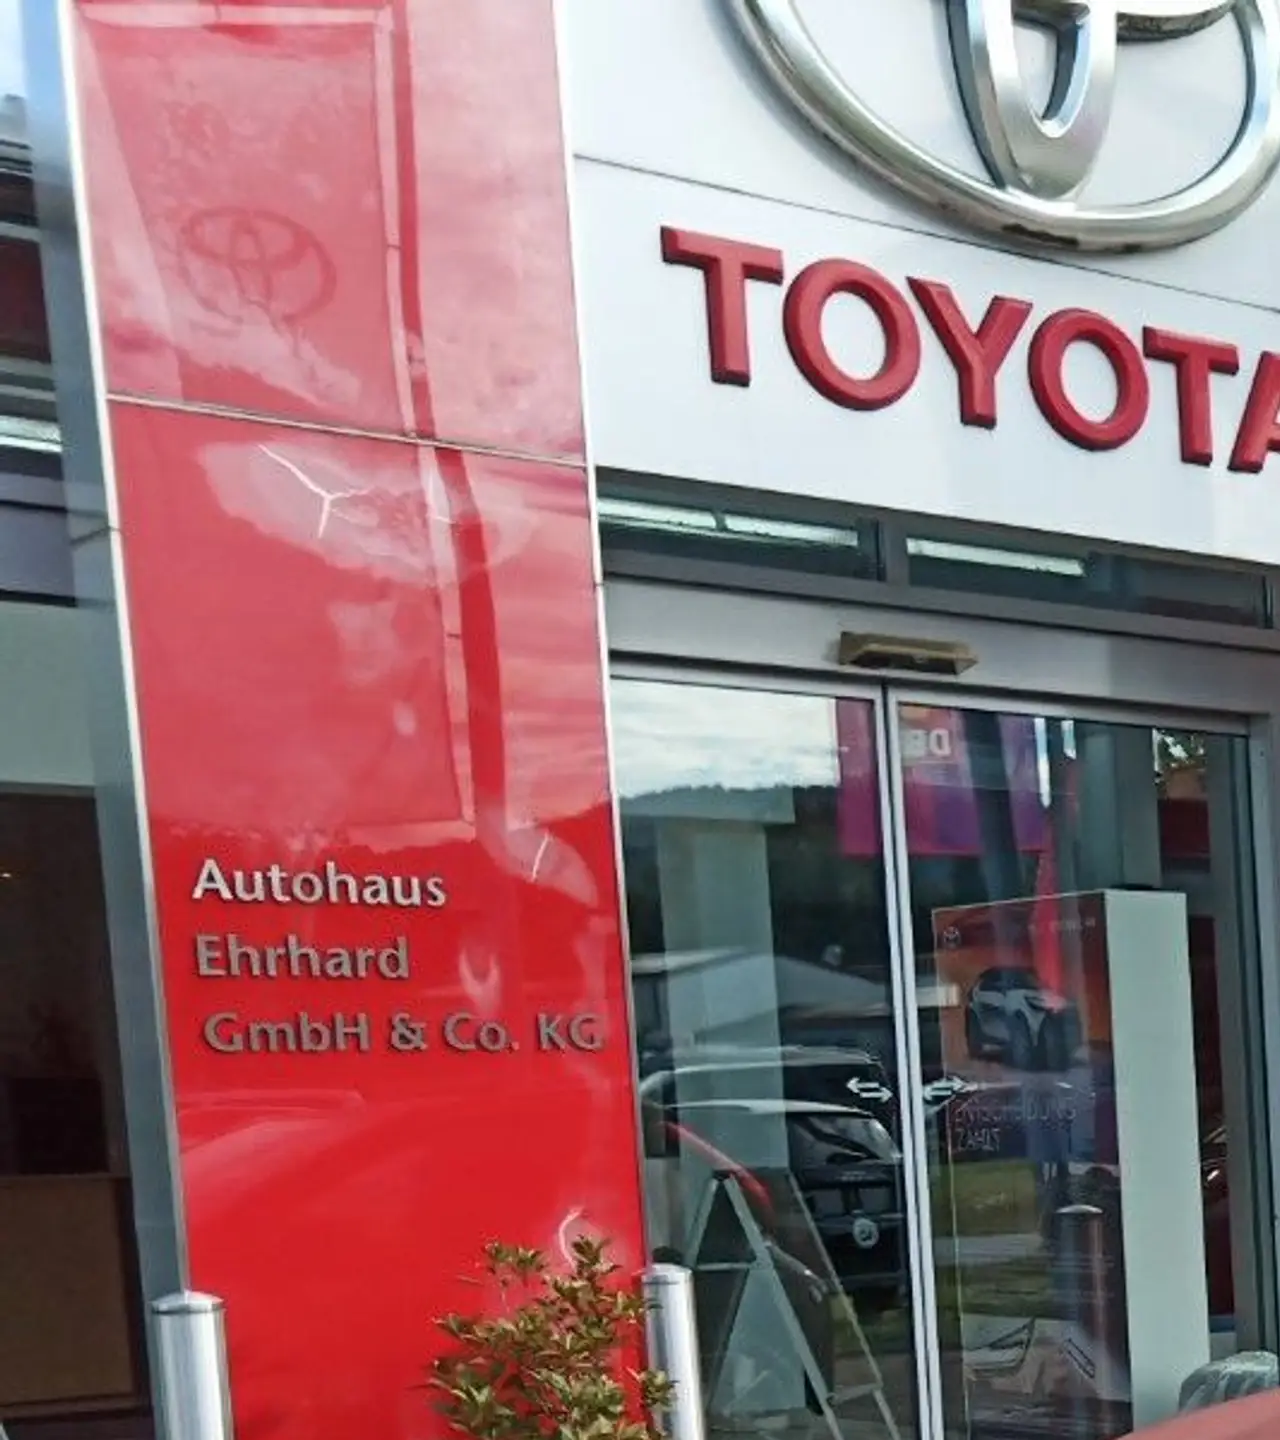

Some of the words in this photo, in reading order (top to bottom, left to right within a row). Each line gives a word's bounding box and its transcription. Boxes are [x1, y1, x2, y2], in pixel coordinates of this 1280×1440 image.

[191, 858, 449, 910] Autohaus
[195, 934, 411, 980] Ehrhard
[203, 1011, 370, 1053] GmbH
[389, 1012, 427, 1053] &
[443, 1014, 519, 1054] Co.
[538, 1013, 606, 1052] KG
